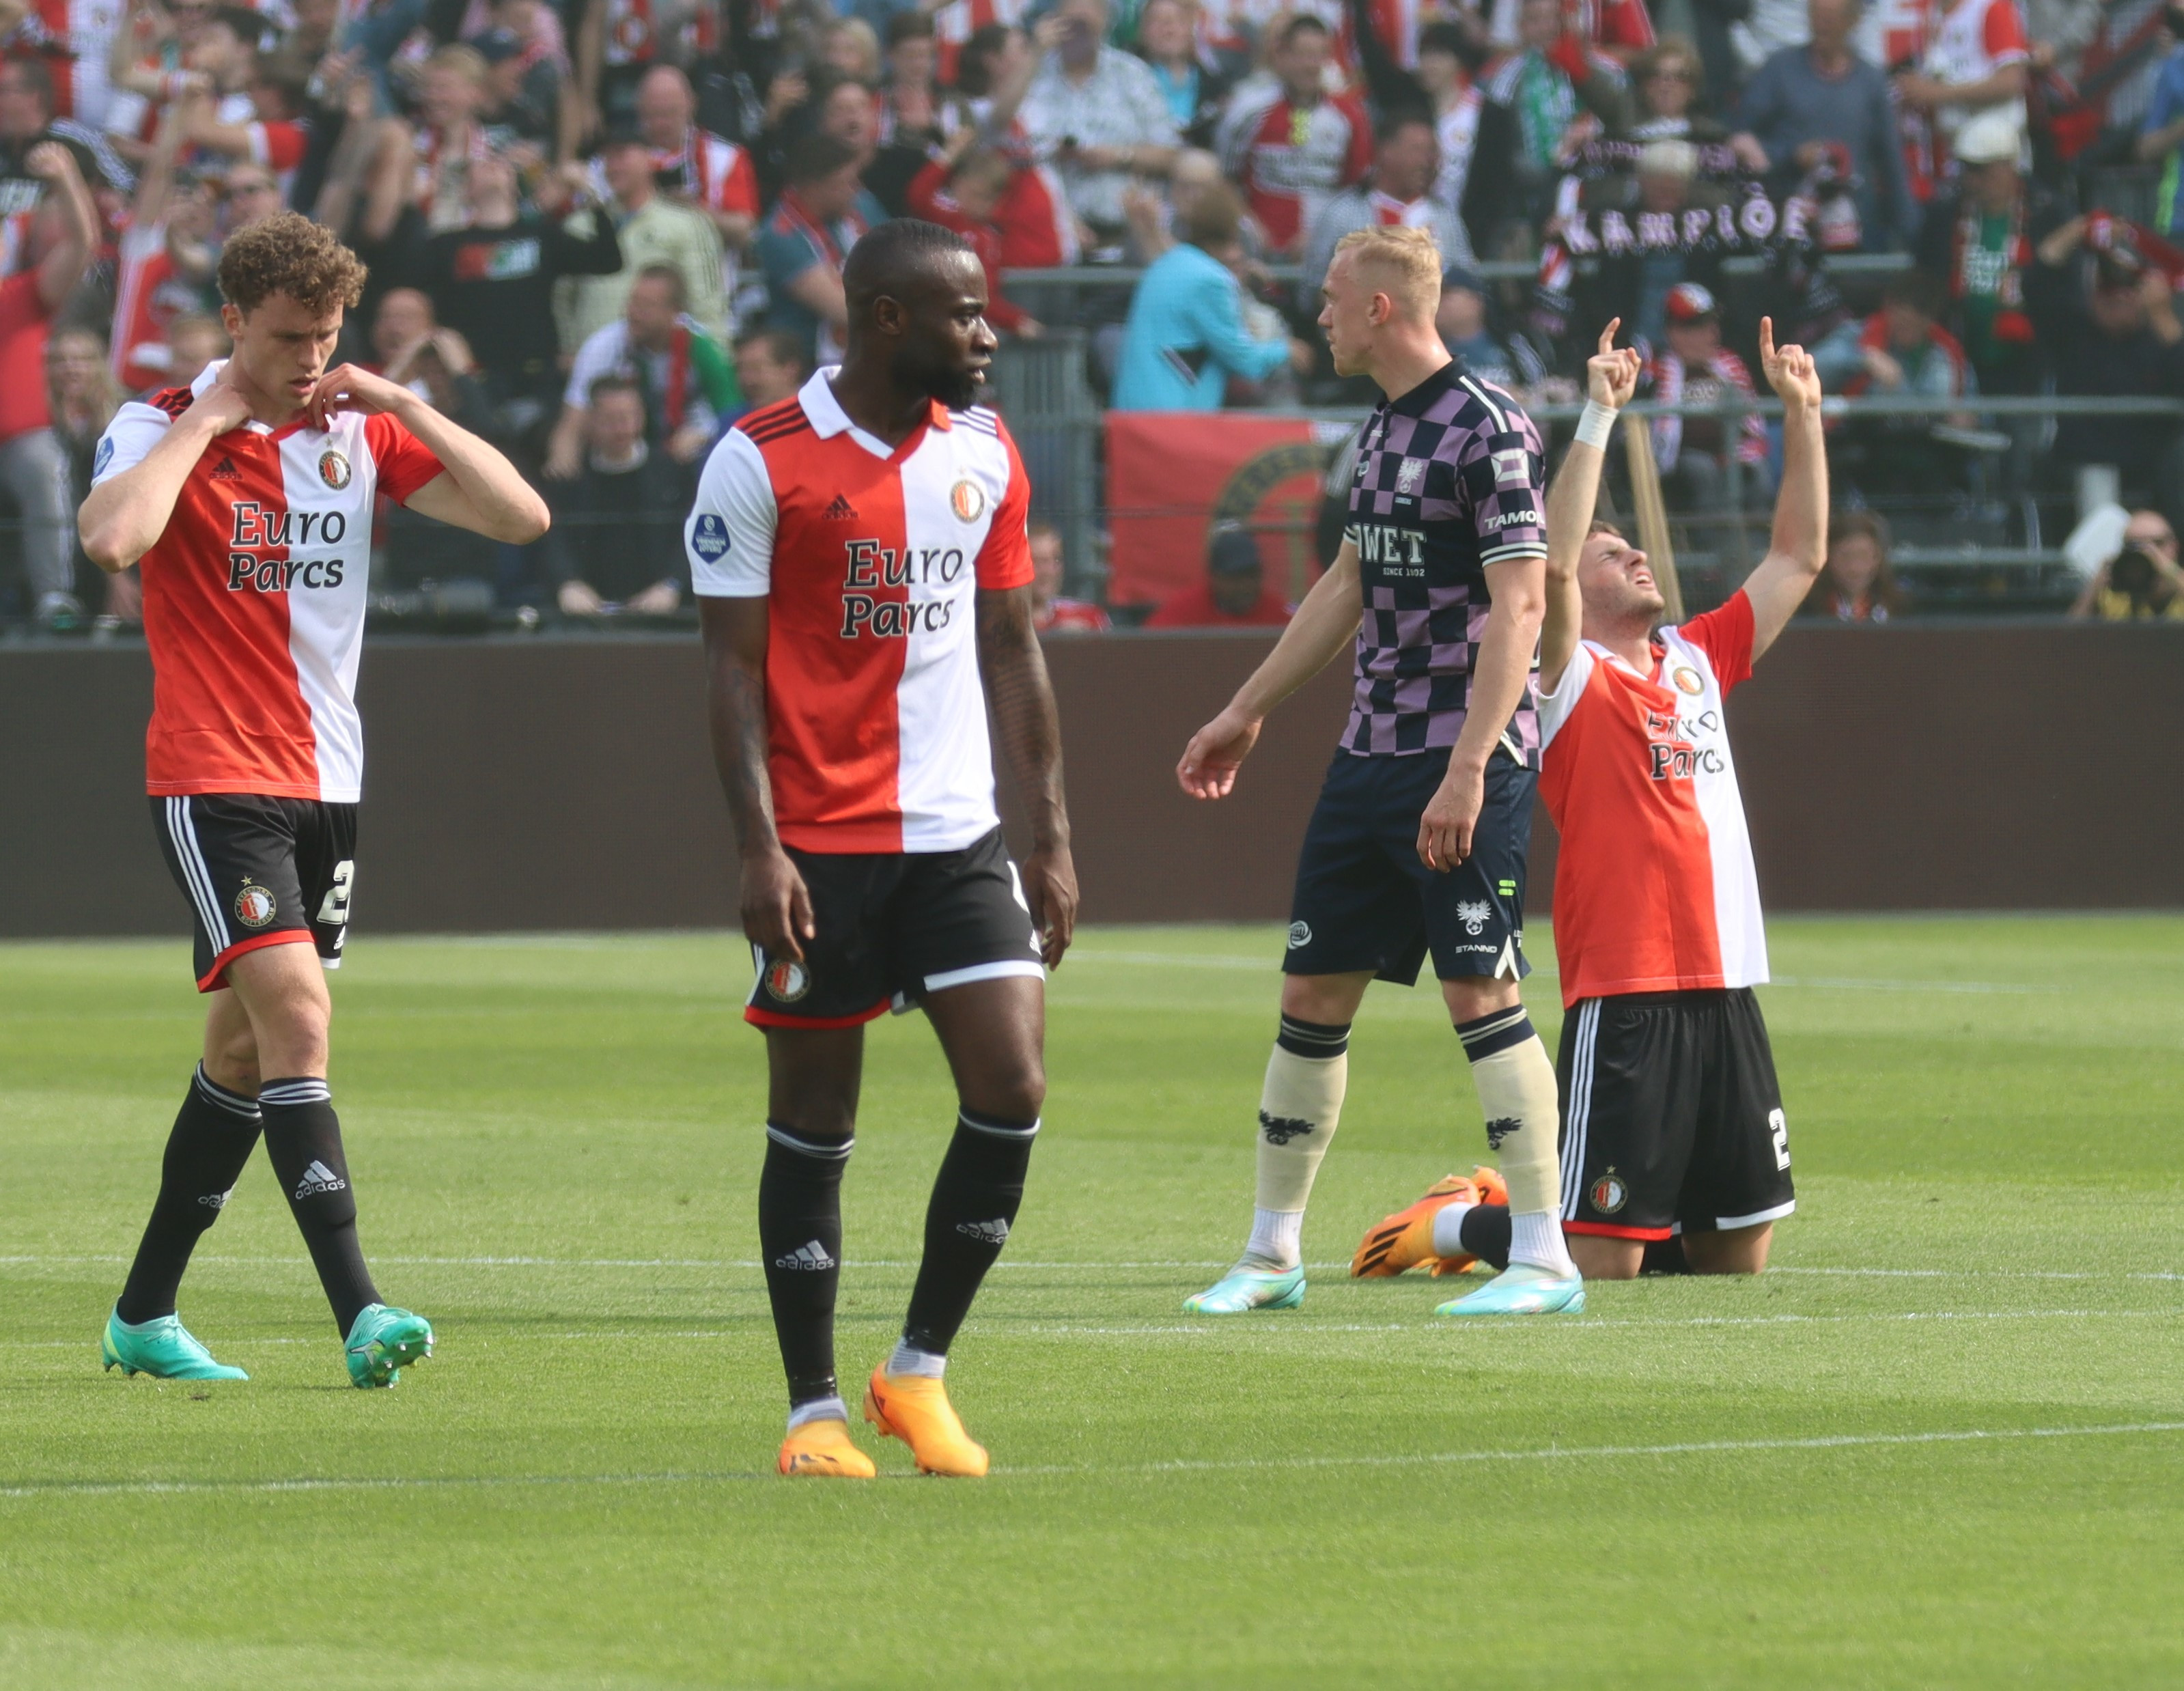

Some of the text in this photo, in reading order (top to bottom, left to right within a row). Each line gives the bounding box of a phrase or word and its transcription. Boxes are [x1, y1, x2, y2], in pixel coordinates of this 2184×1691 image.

[230, 501, 346, 547] Euro
[227, 552, 344, 592] Parcs
[843, 538, 964, 589] Euro
[840, 593, 955, 639] Parcs
[1649, 742, 1725, 780] Parcs
[316, 860, 355, 925] 2
[1455, 944, 1498, 953] STANNO
[295, 1179, 346, 1200] adidas
[775, 1258, 835, 1271] adidas
